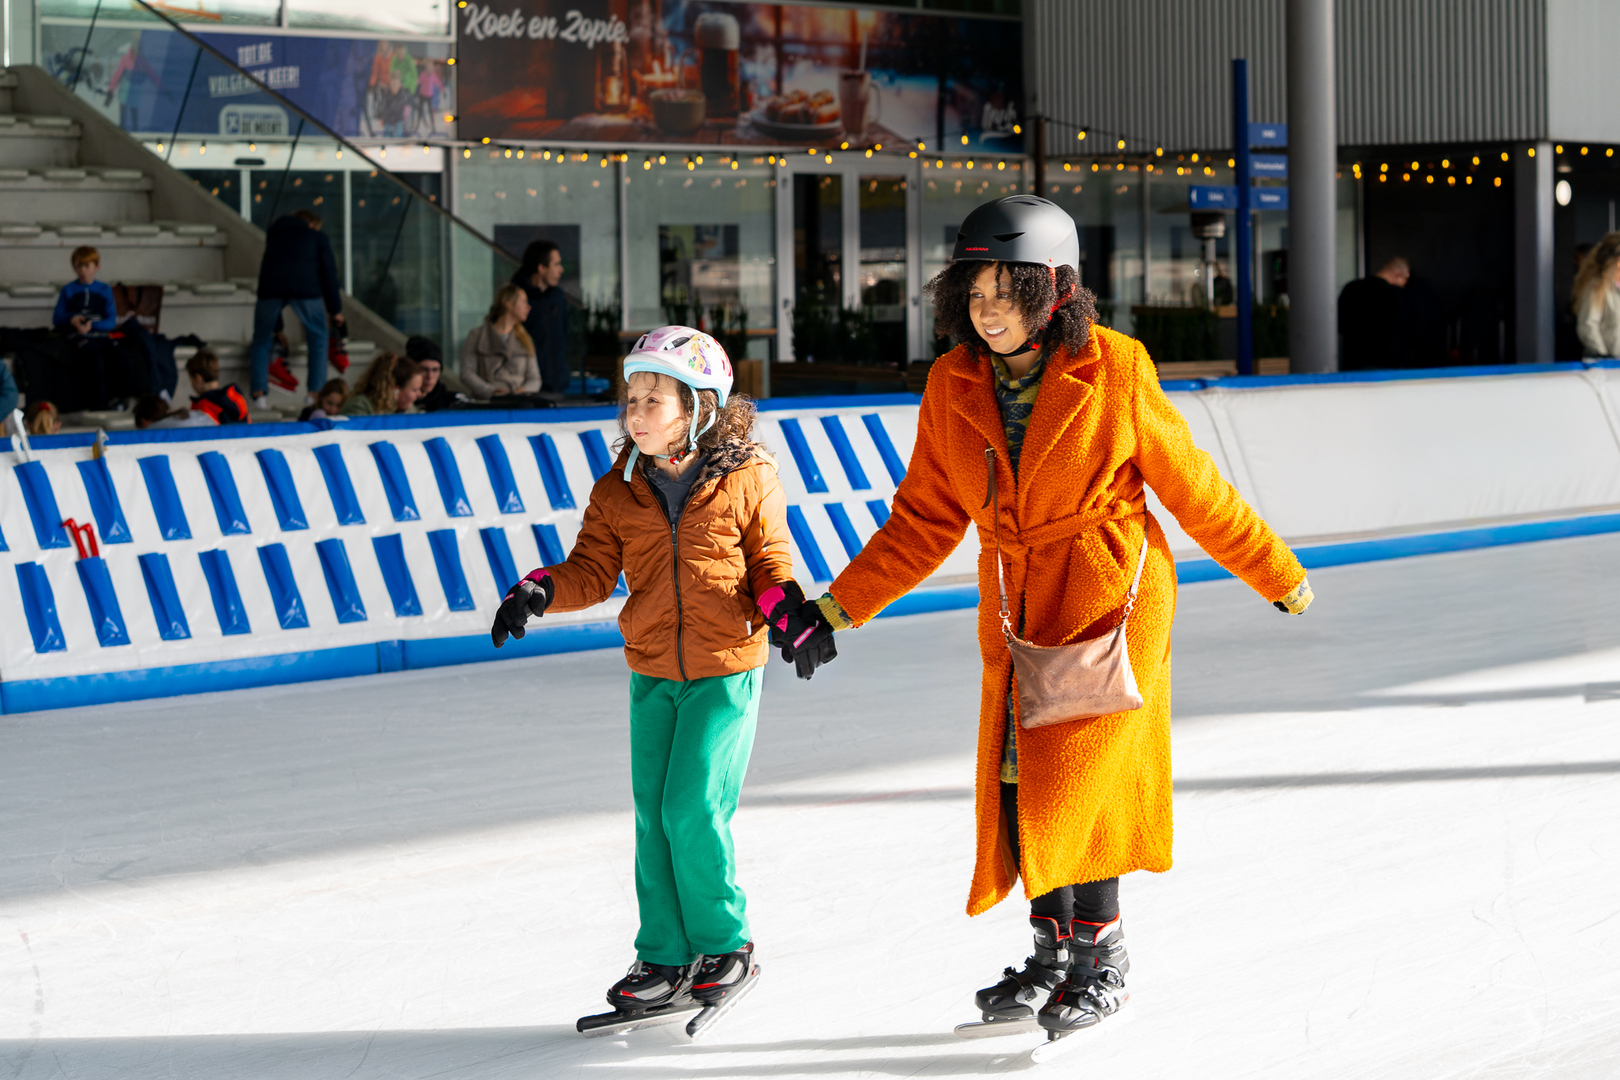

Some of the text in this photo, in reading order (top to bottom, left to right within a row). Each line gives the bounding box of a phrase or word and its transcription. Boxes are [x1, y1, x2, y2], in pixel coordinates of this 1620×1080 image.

[463, 3, 525, 41] Koek
[527, 15, 559, 40] en
[237, 42, 273, 66] TOT DE
[267, 66, 300, 87] KEER!
